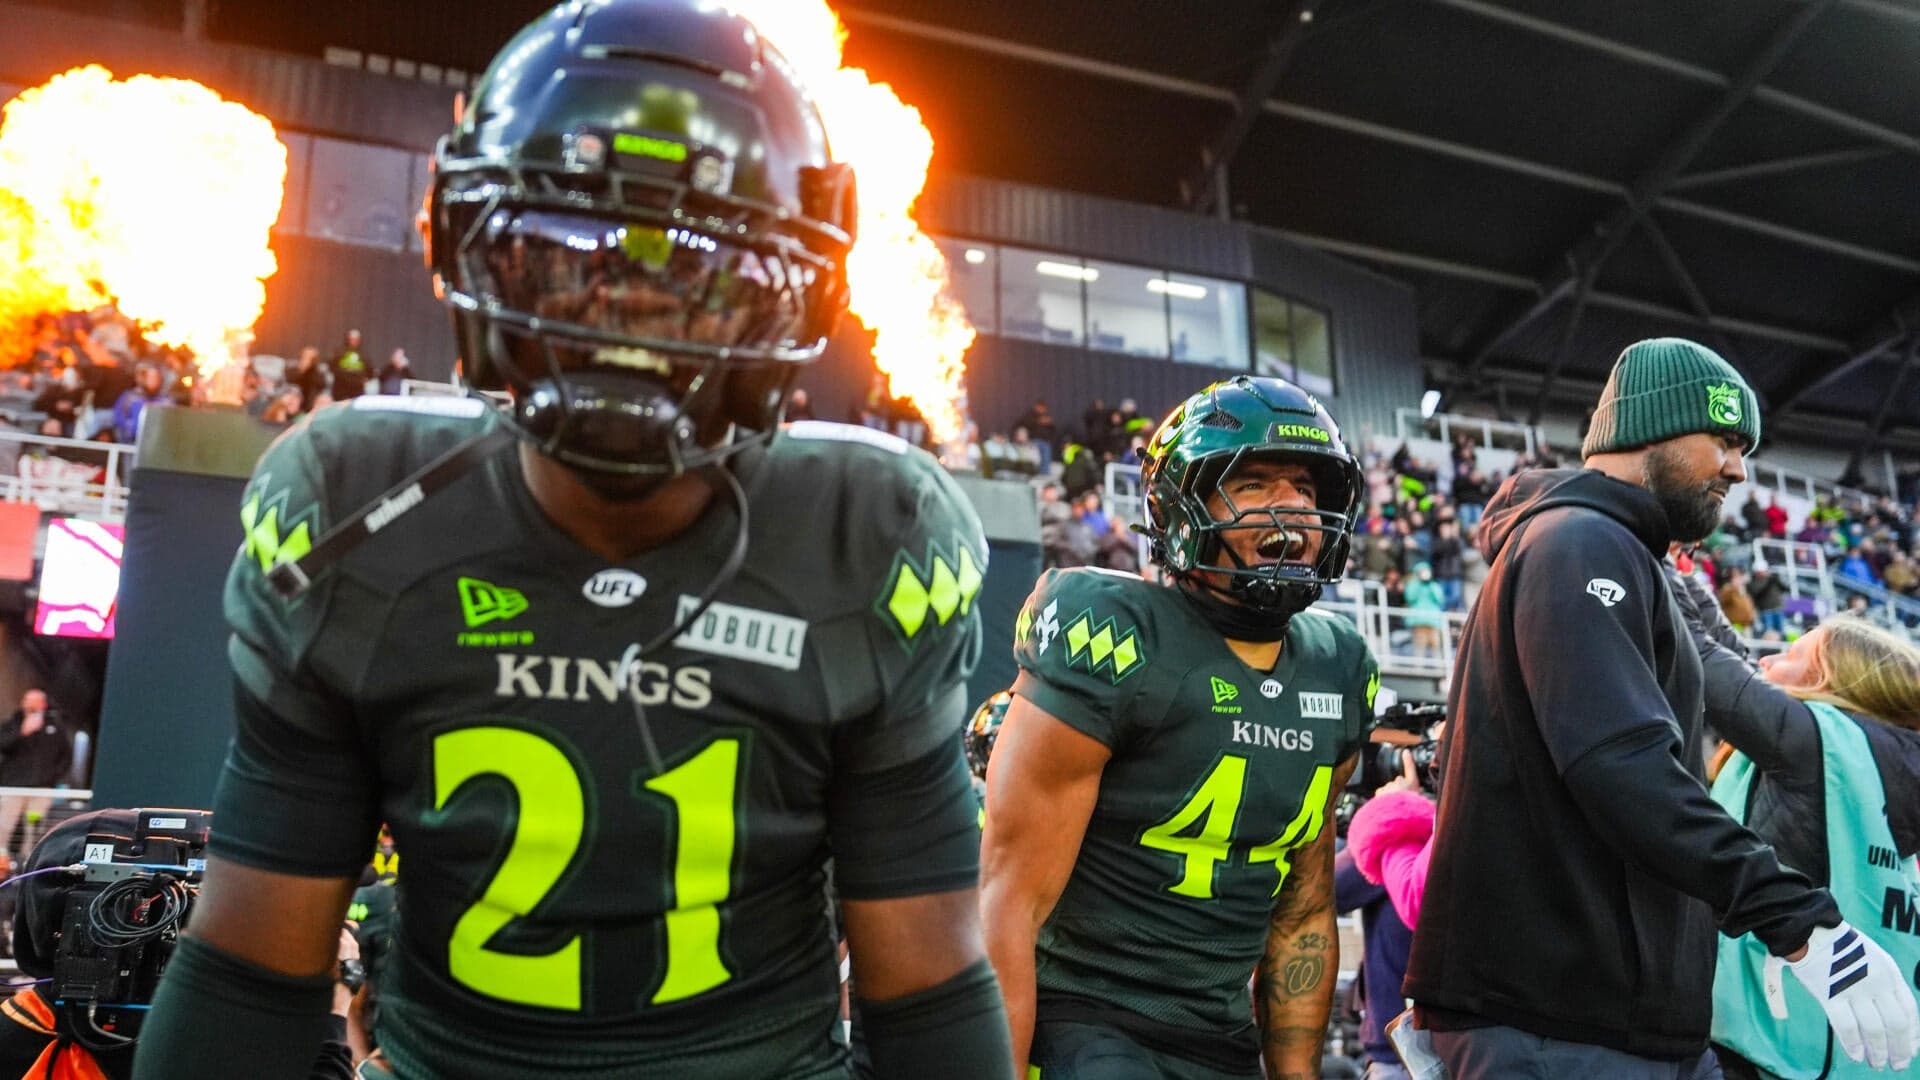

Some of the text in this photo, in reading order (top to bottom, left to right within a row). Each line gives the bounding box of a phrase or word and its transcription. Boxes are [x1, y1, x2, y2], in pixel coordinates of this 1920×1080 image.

[1278, 424, 1330, 443] KINGS
[591, 577, 640, 599] UFL
[495, 653, 713, 710] KINGS
[1301, 695, 1342, 715] NOBULL
[1232, 720, 1314, 752] KINGS
[1139, 755, 1333, 898] 44
[89, 847, 107, 861] A1
[433, 726, 739, 1011] 21
